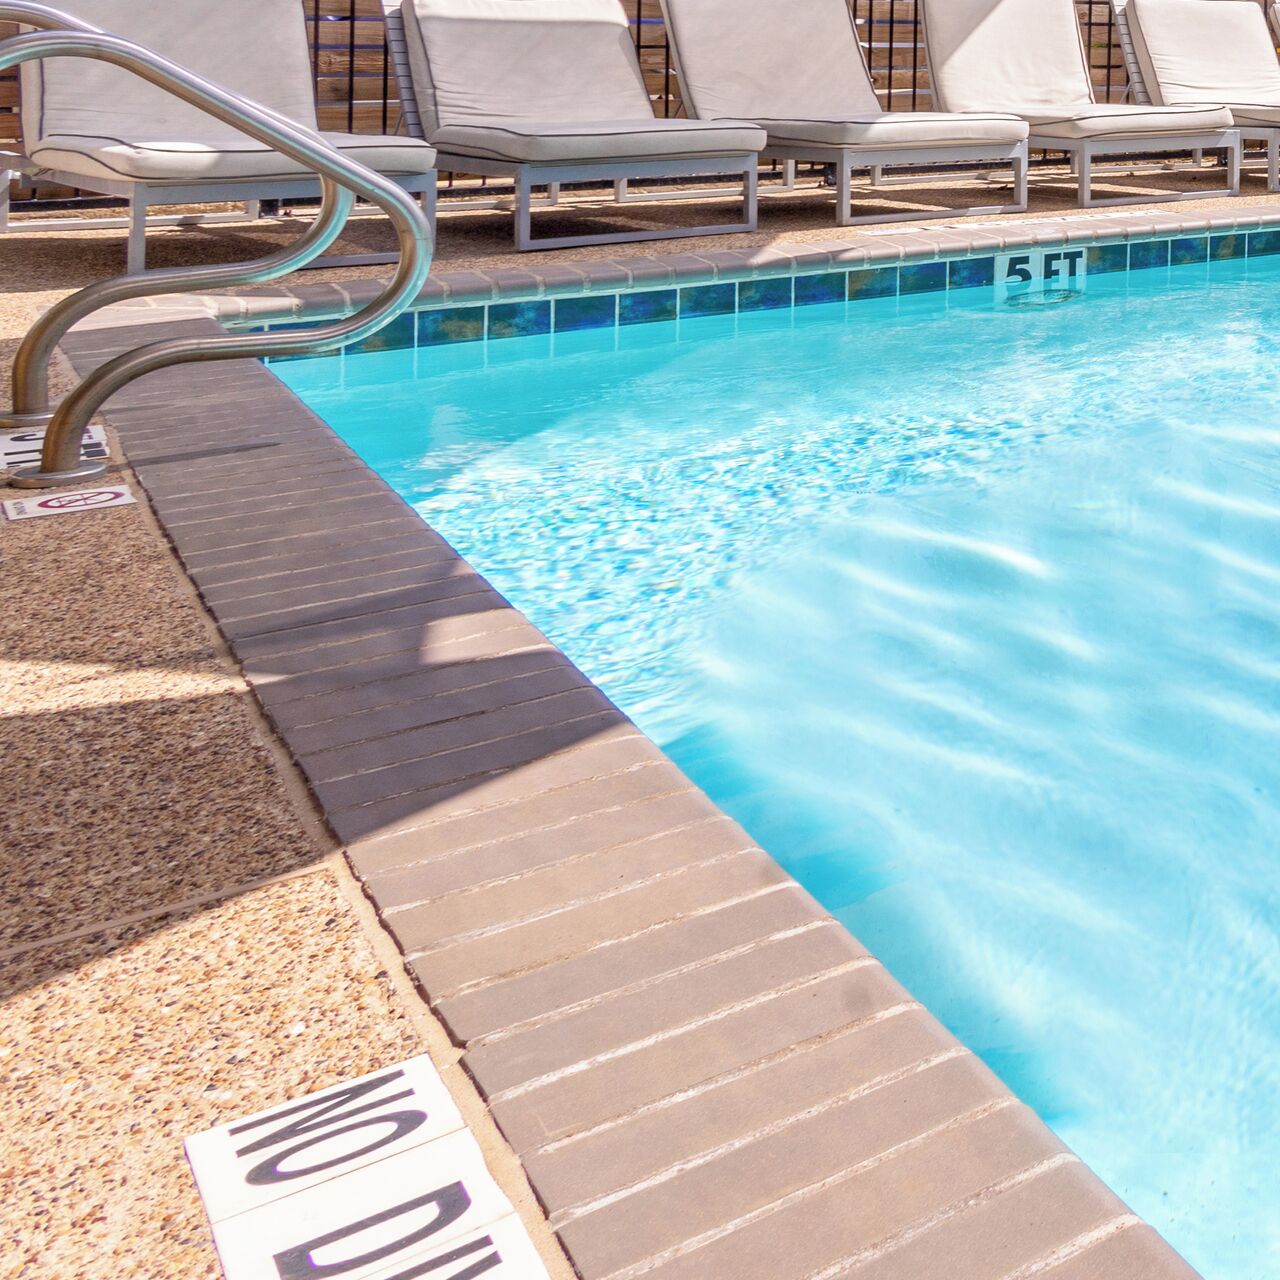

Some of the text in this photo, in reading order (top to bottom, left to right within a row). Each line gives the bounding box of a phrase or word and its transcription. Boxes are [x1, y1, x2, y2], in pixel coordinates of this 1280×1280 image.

[1005, 250, 1083, 284] 5 FT
[228, 1068, 428, 1186] NO
